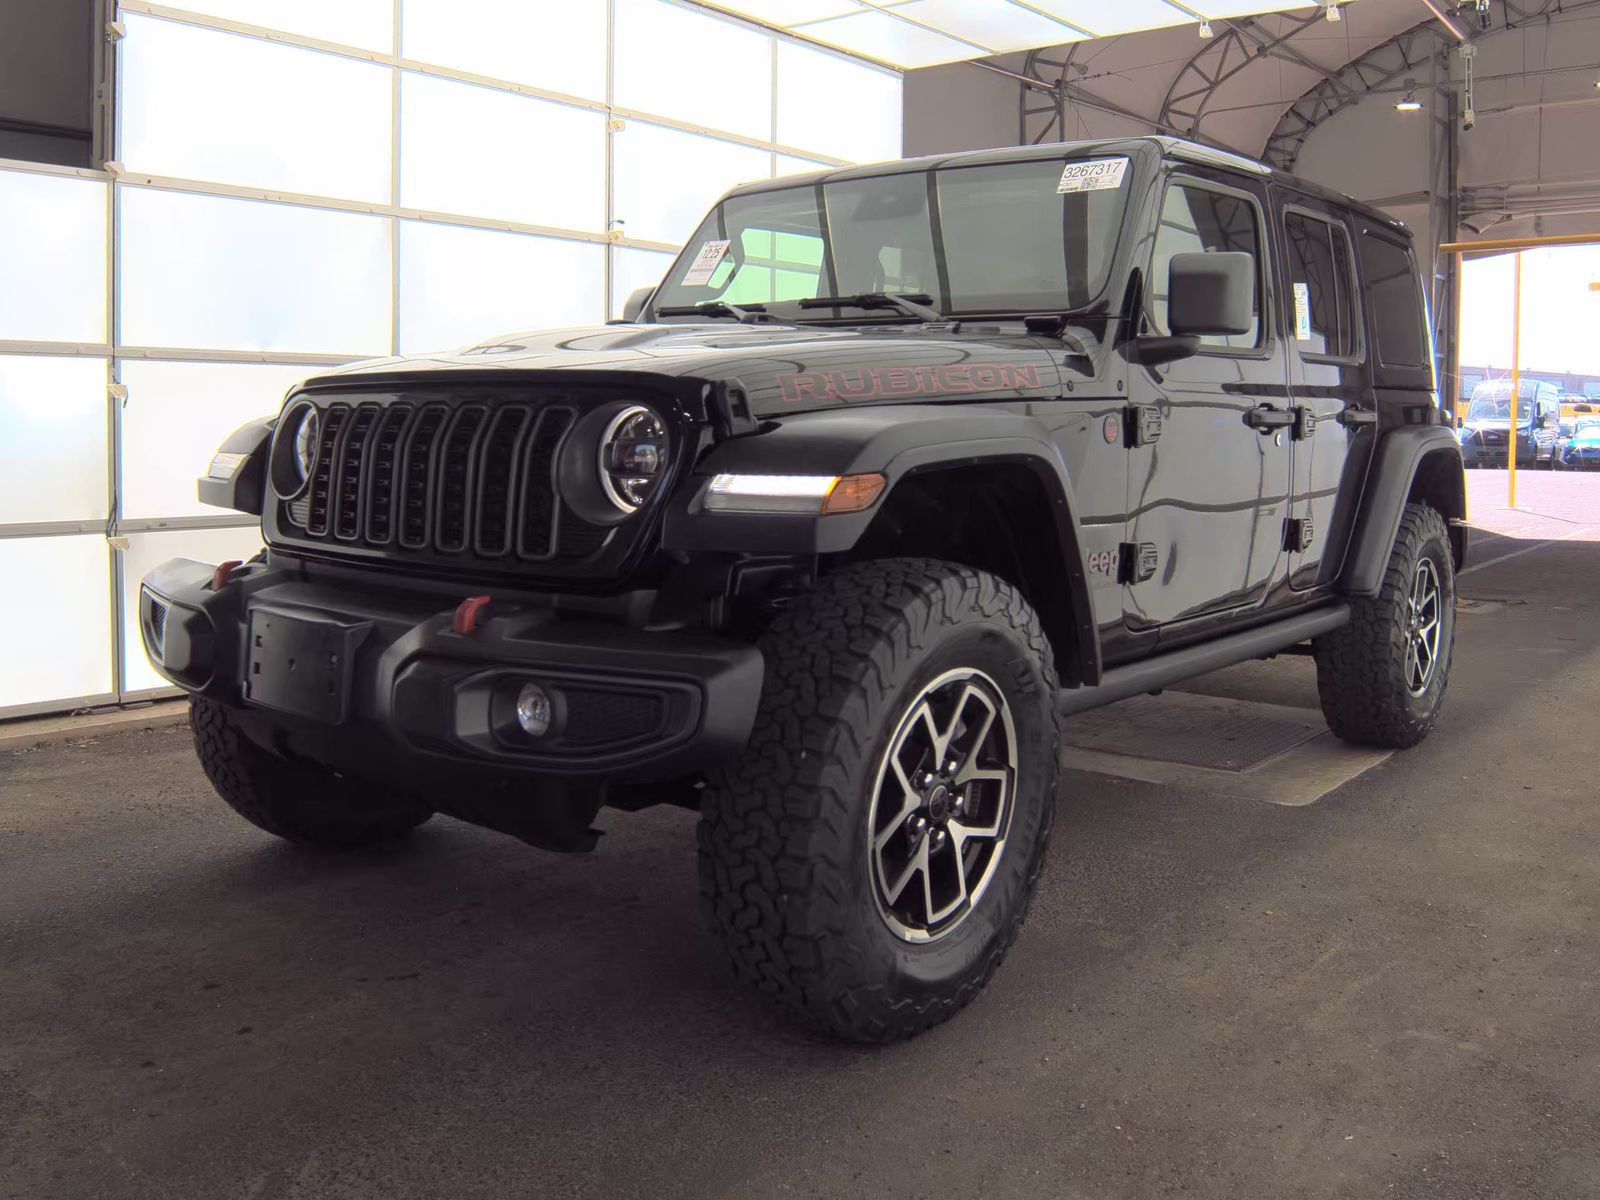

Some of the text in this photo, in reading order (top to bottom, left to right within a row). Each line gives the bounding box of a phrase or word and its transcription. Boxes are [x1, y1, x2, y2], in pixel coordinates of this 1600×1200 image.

[1063, 161, 1122, 179] 3267317
[776, 363, 1041, 402] RUBICON
[1086, 548, 1118, 577] eep
